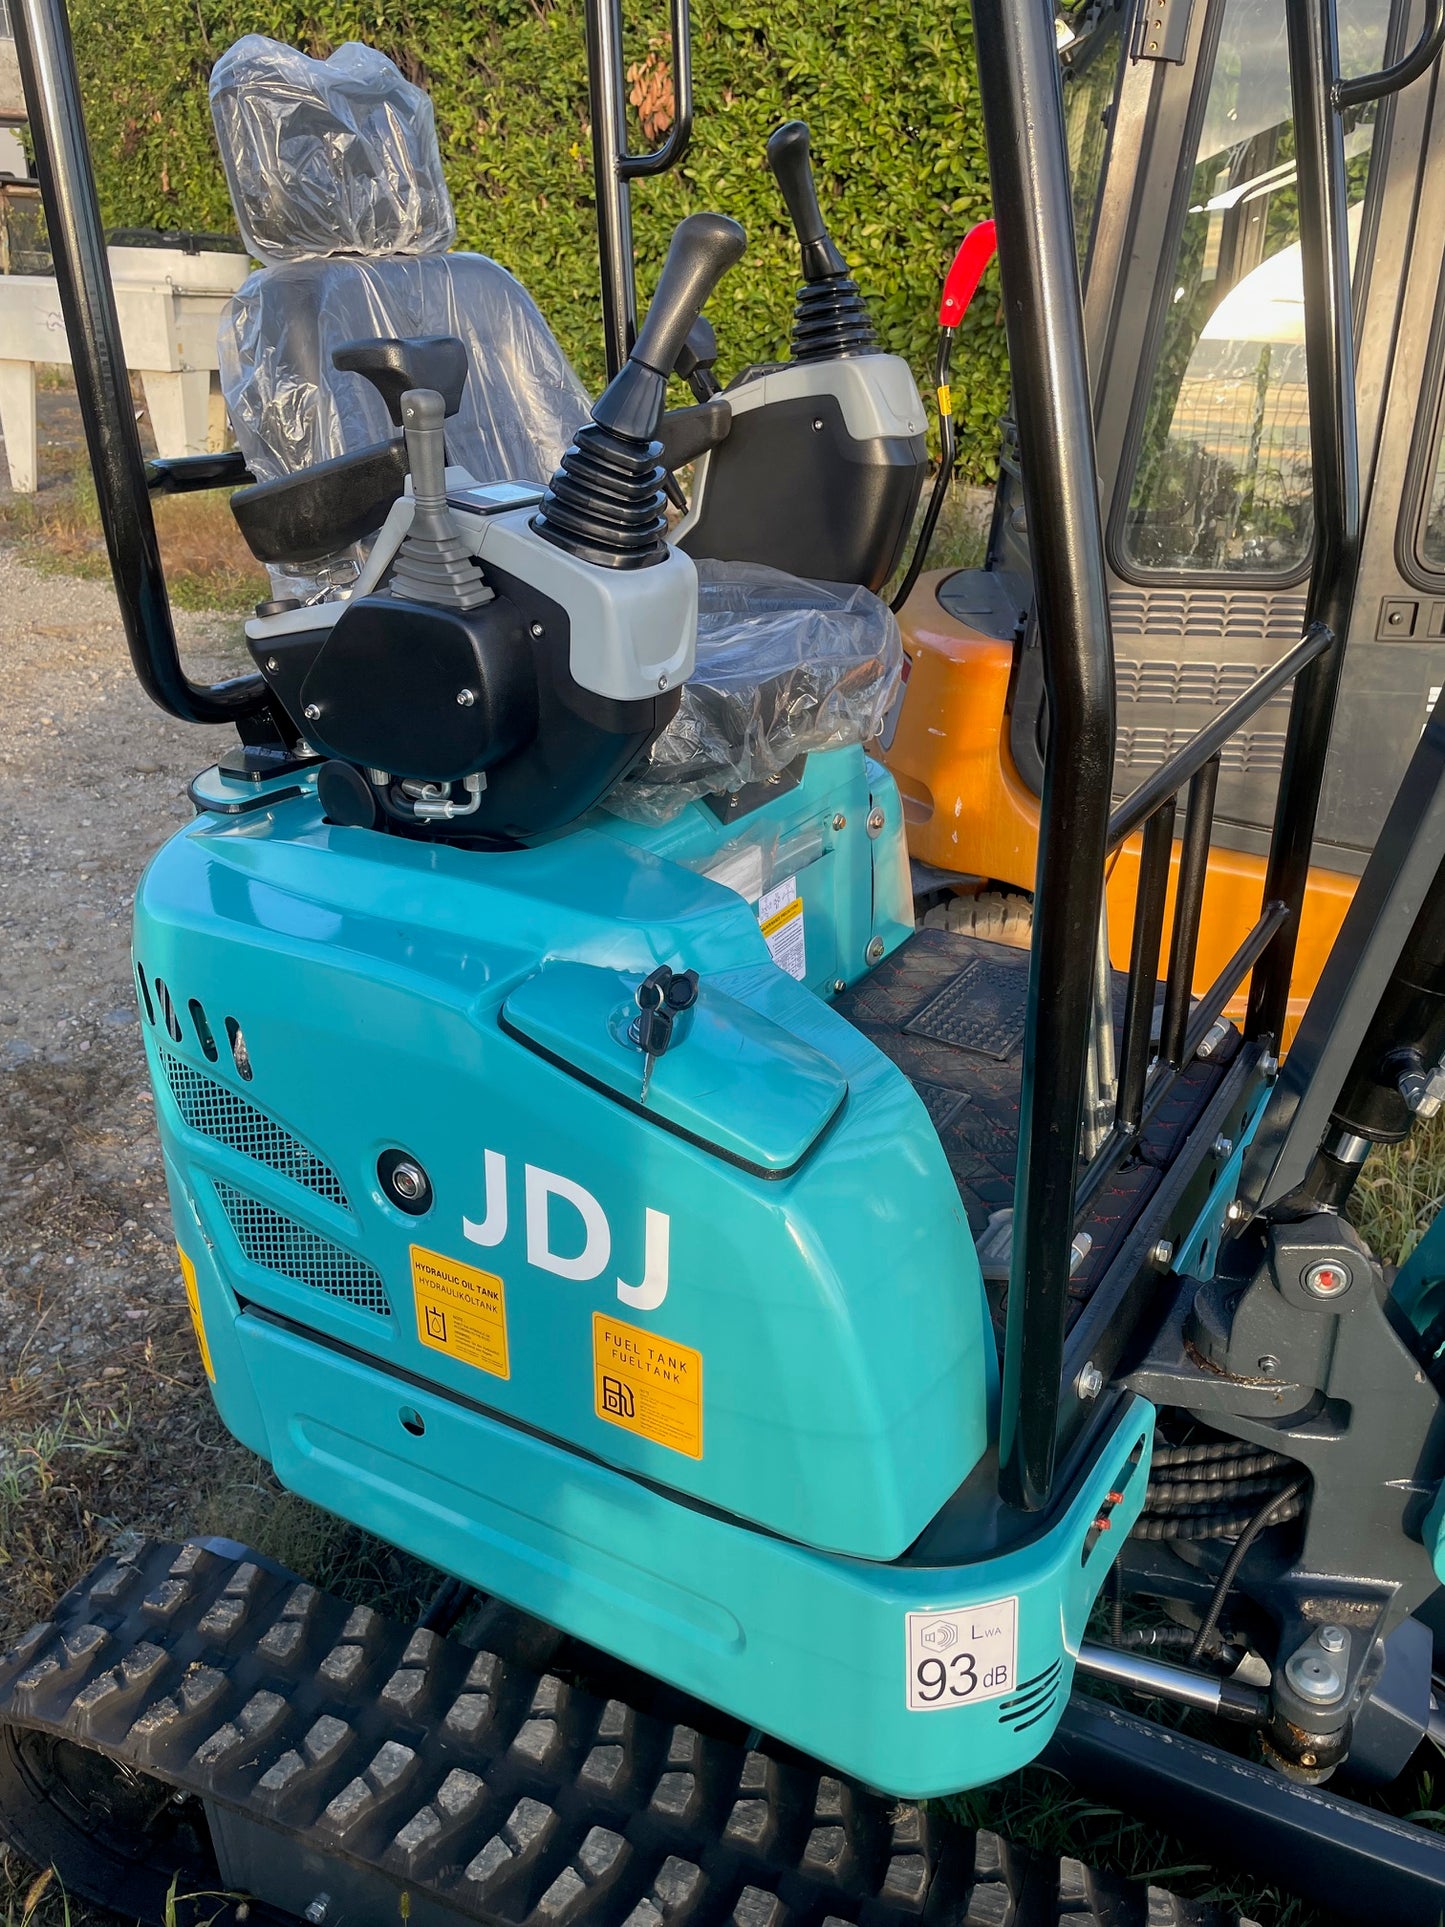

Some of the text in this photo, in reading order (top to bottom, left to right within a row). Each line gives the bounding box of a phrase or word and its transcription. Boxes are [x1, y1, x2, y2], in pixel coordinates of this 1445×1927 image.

[463, 1148, 670, 1311] JDJ
[415, 1261, 500, 1301] HYDRAULIC OIL TANK
[605, 1331, 687, 1374] FUEL TANK
[612, 1348, 680, 1385] FUELTANK
[917, 1653, 1008, 1701] 93 dB
